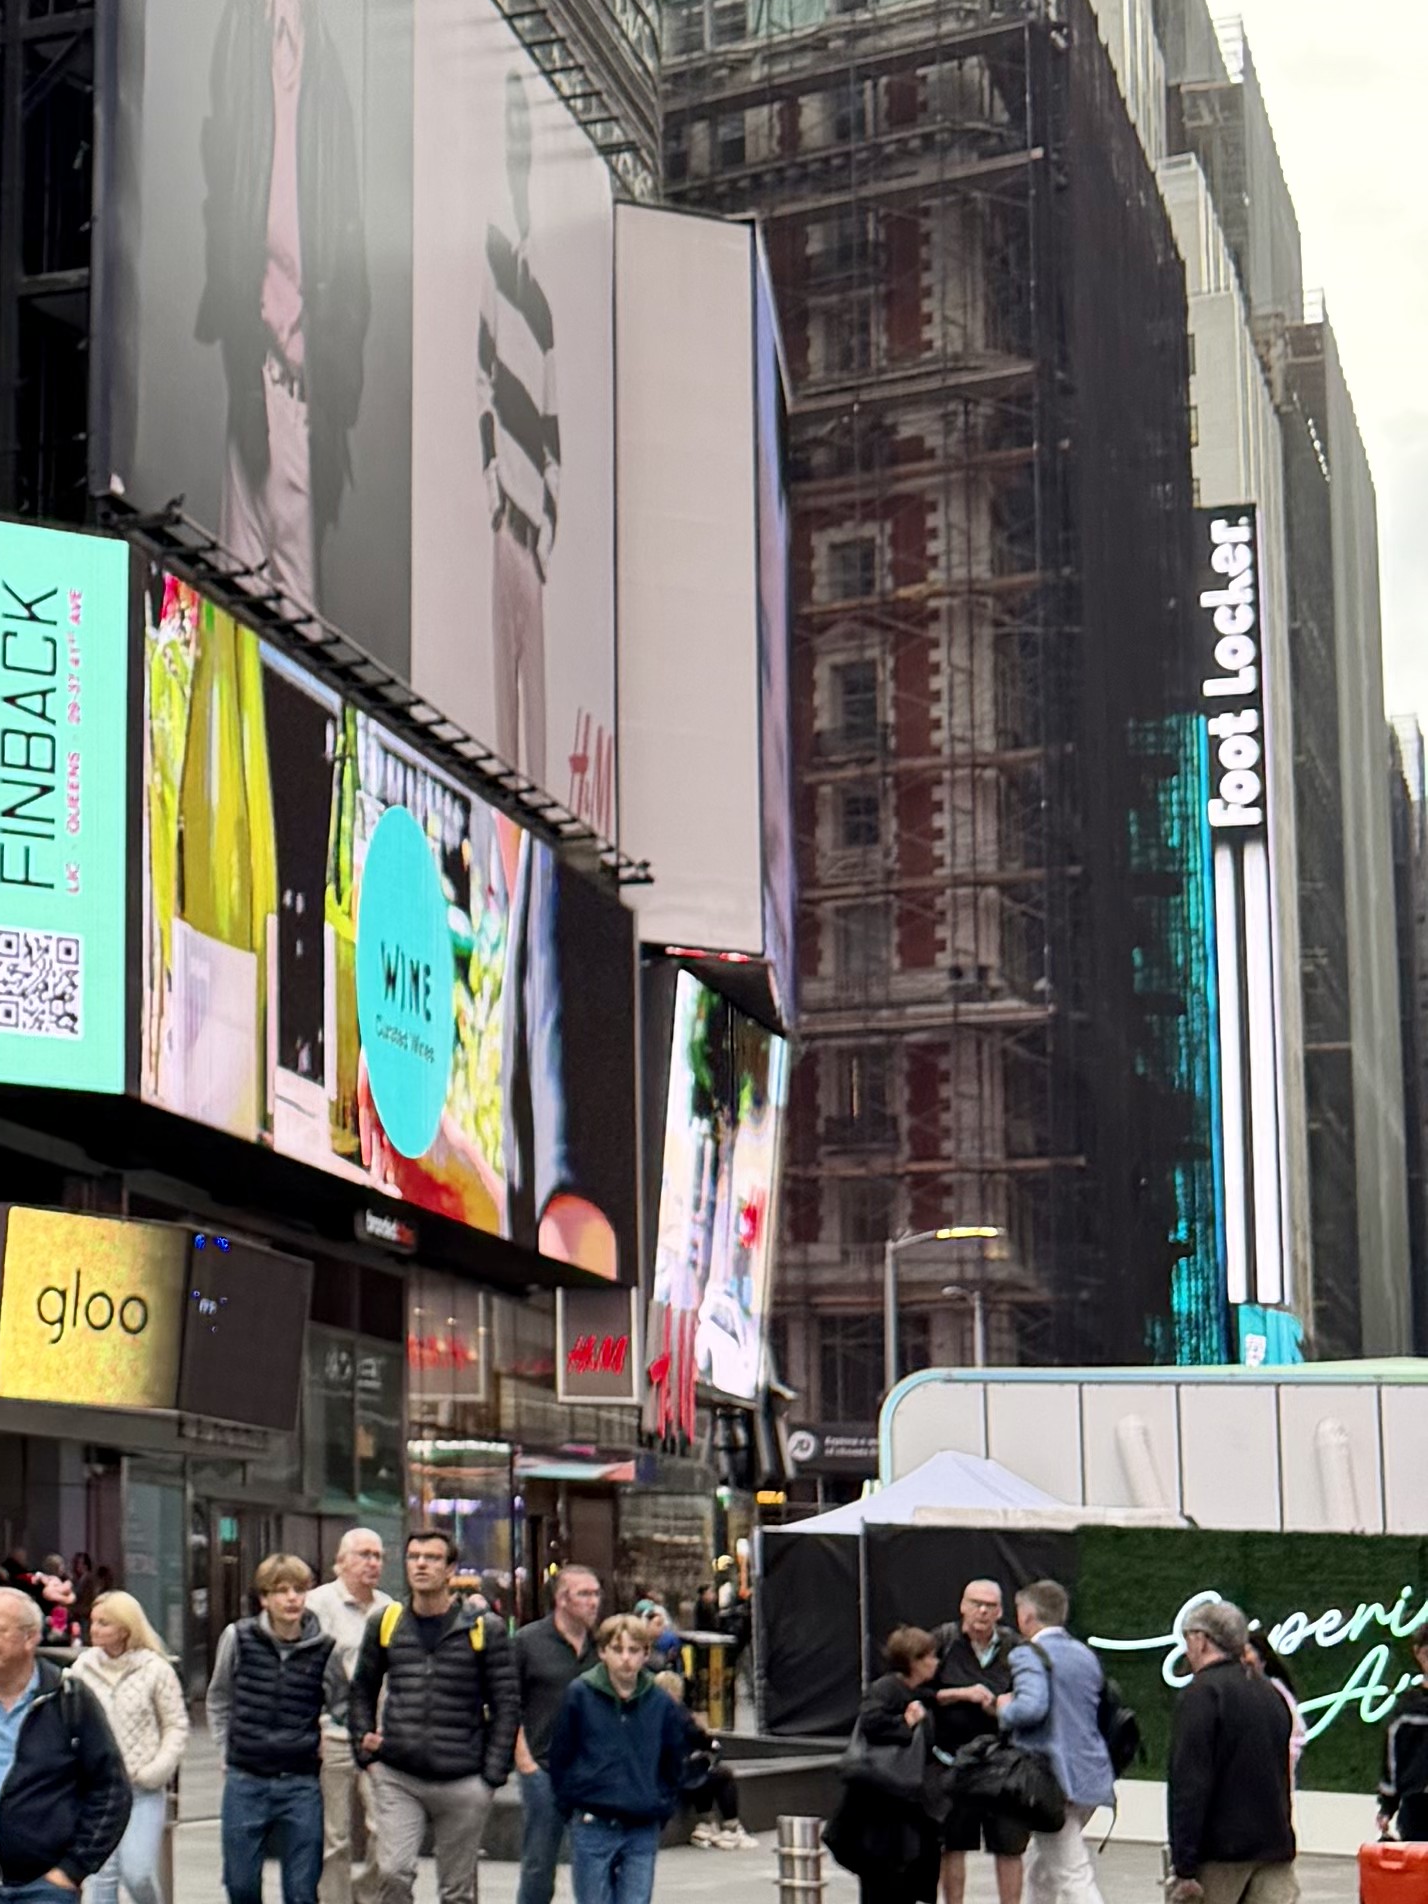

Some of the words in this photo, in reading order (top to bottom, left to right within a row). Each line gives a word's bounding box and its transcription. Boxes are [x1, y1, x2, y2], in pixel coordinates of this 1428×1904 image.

[68, 587, 83, 626] AVE
[66, 752, 81, 836] QUEENS
[1208, 708, 1263, 828] Foot
[380, 940, 432, 1023] WINE
[37, 1268, 149, 1345] gloo
